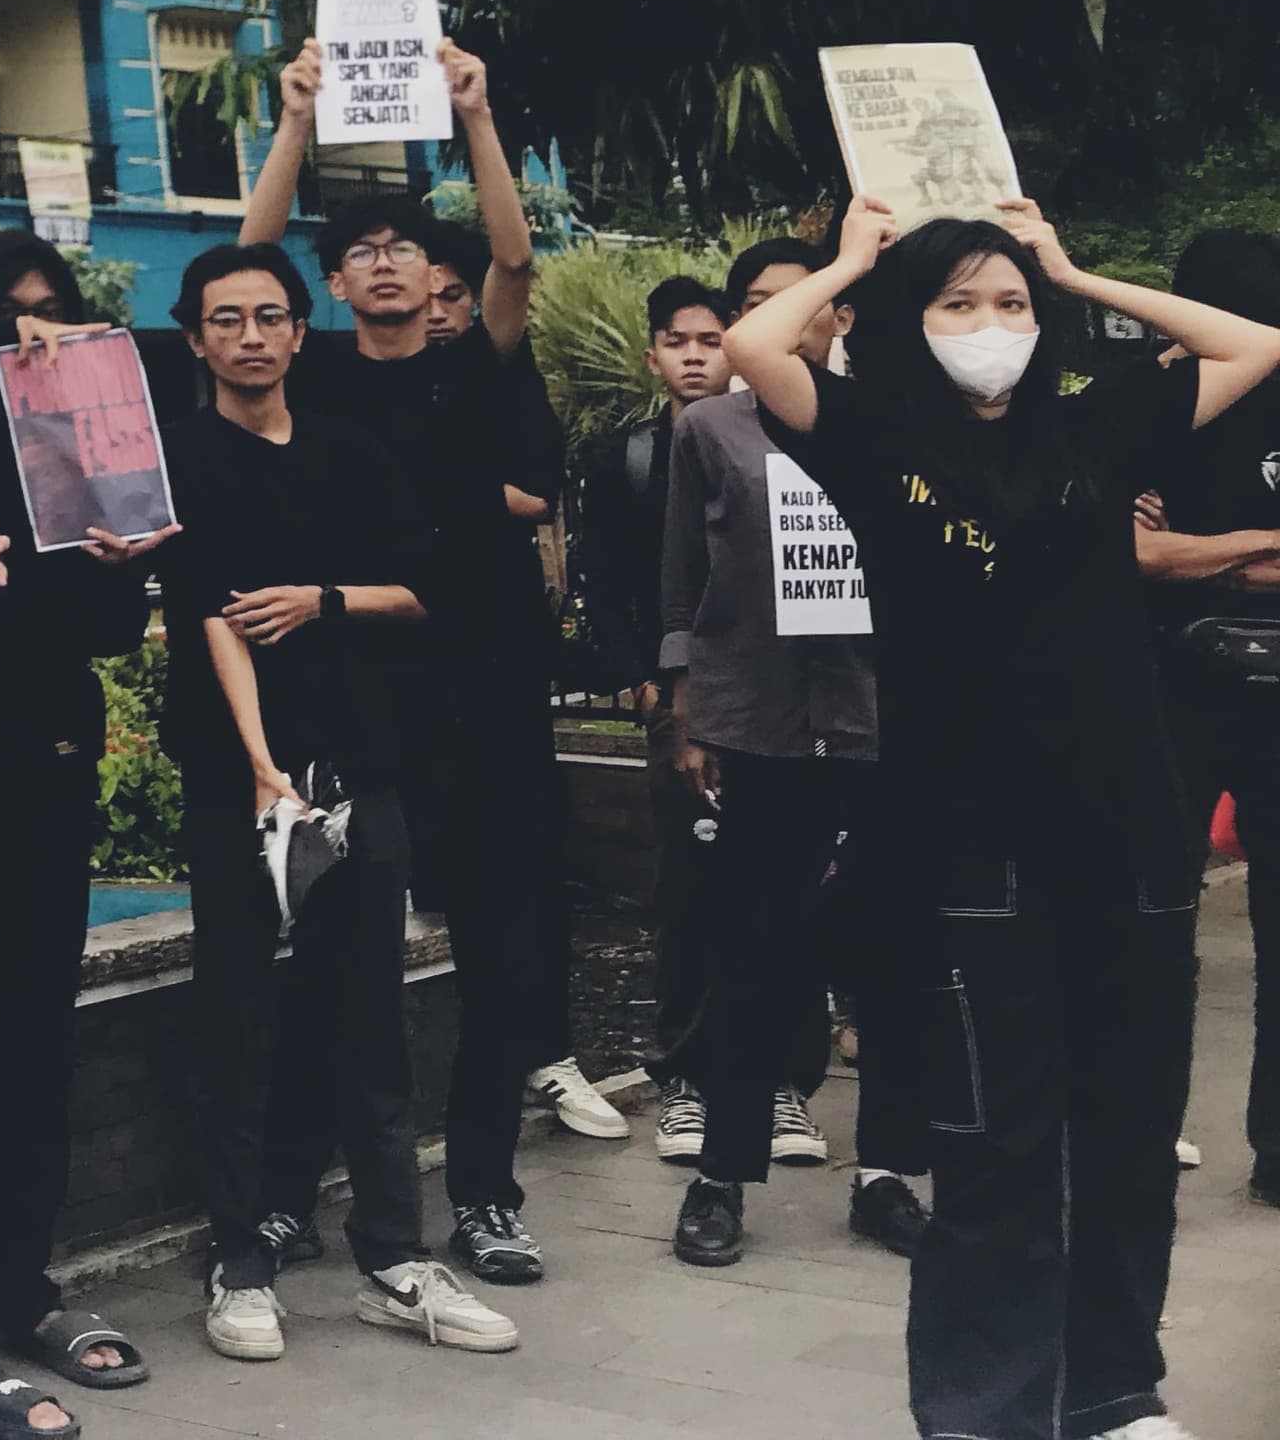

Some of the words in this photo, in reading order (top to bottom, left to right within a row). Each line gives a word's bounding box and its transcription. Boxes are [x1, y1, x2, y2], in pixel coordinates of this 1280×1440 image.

[327, 42, 349, 61] TNI
[354, 40, 388, 59] JADI
[338, 63, 373, 81] SIPIL
[379, 61, 419, 80] YANG
[351, 83, 408, 102] ANGKAT
[781, 491, 813, 506] KALO
[780, 514, 815, 531] BISA
[818, 514, 848, 531] SEE
[782, 579, 846, 600] RAKYAT
